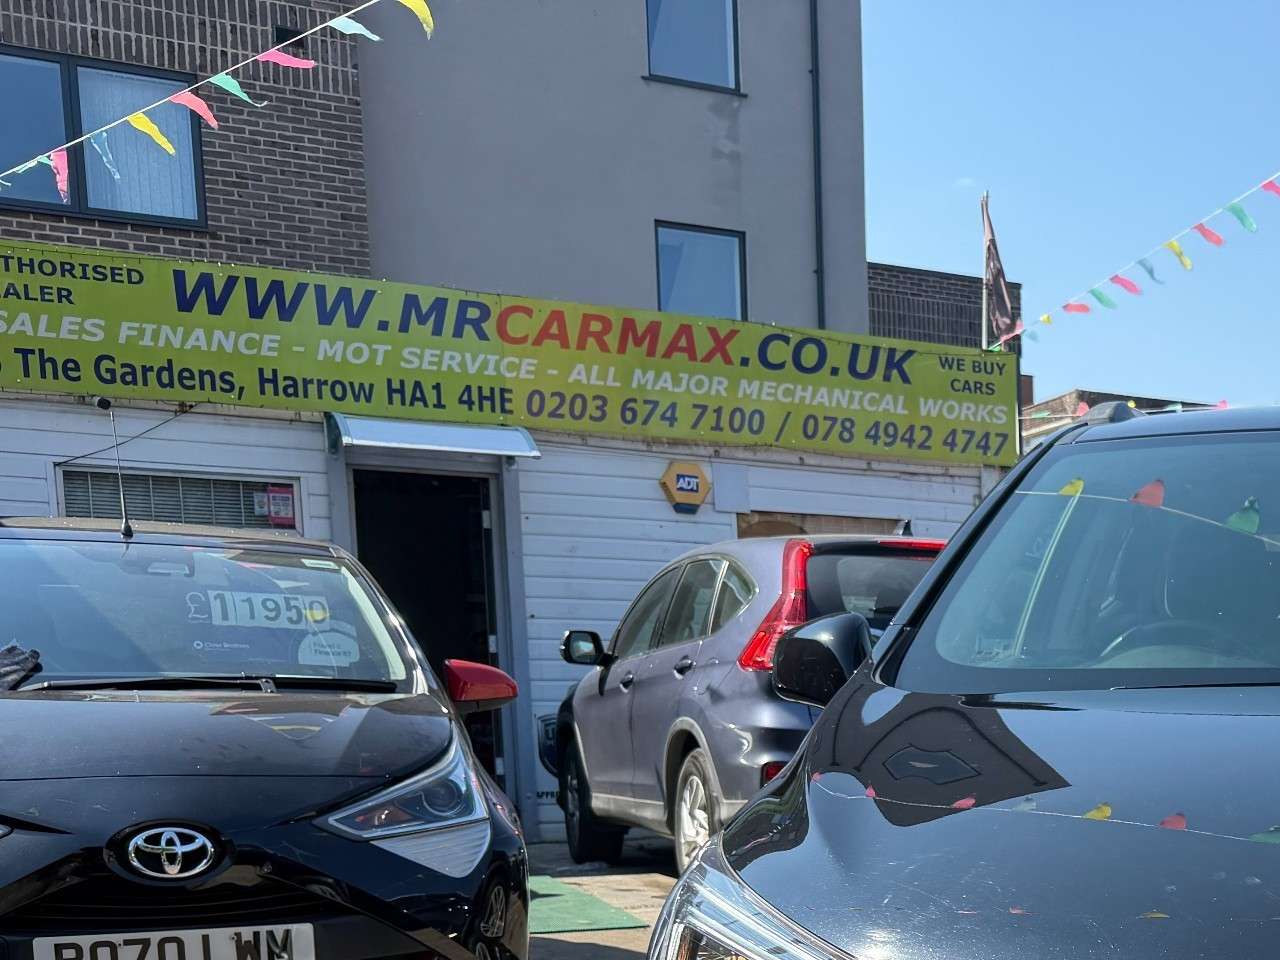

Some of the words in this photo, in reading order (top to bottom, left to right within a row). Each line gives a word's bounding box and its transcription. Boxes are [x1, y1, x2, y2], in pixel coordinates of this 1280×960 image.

[0, 282, 75, 305] ALER
[172, 268, 917, 385] WWW.MRCARMAX.CO.UK
[118, 321, 281, 357] FINANCE
[316, 339, 392, 366] MOT
[400, 347, 538, 379] SERVICE
[567, 363, 621, 387] ALL
[631, 368, 729, 397] MAJOR
[737, 379, 909, 415] MECHANICAL
[919, 397, 1008, 425] WORKS
[938, 355, 966, 372] WE
[972, 359, 1007, 377] BUY
[950, 378, 996, 396] CARS
[13, 347, 82, 382] The
[94, 354, 245, 401] Gardens,
[258, 367, 375, 404] Harrow
[386, 378, 447, 410] HA1
[458, 384, 514, 415] 4HE
[526, 389, 609, 422] 0203
[619, 397, 679, 428] 674
[690, 403, 766, 436] 7100
[774, 411, 792, 442] /
[802, 414, 856, 444] 078
[864, 420, 934, 450] 4942
[942, 428, 1009, 457] 4747
[677, 476, 699, 491] ADT
